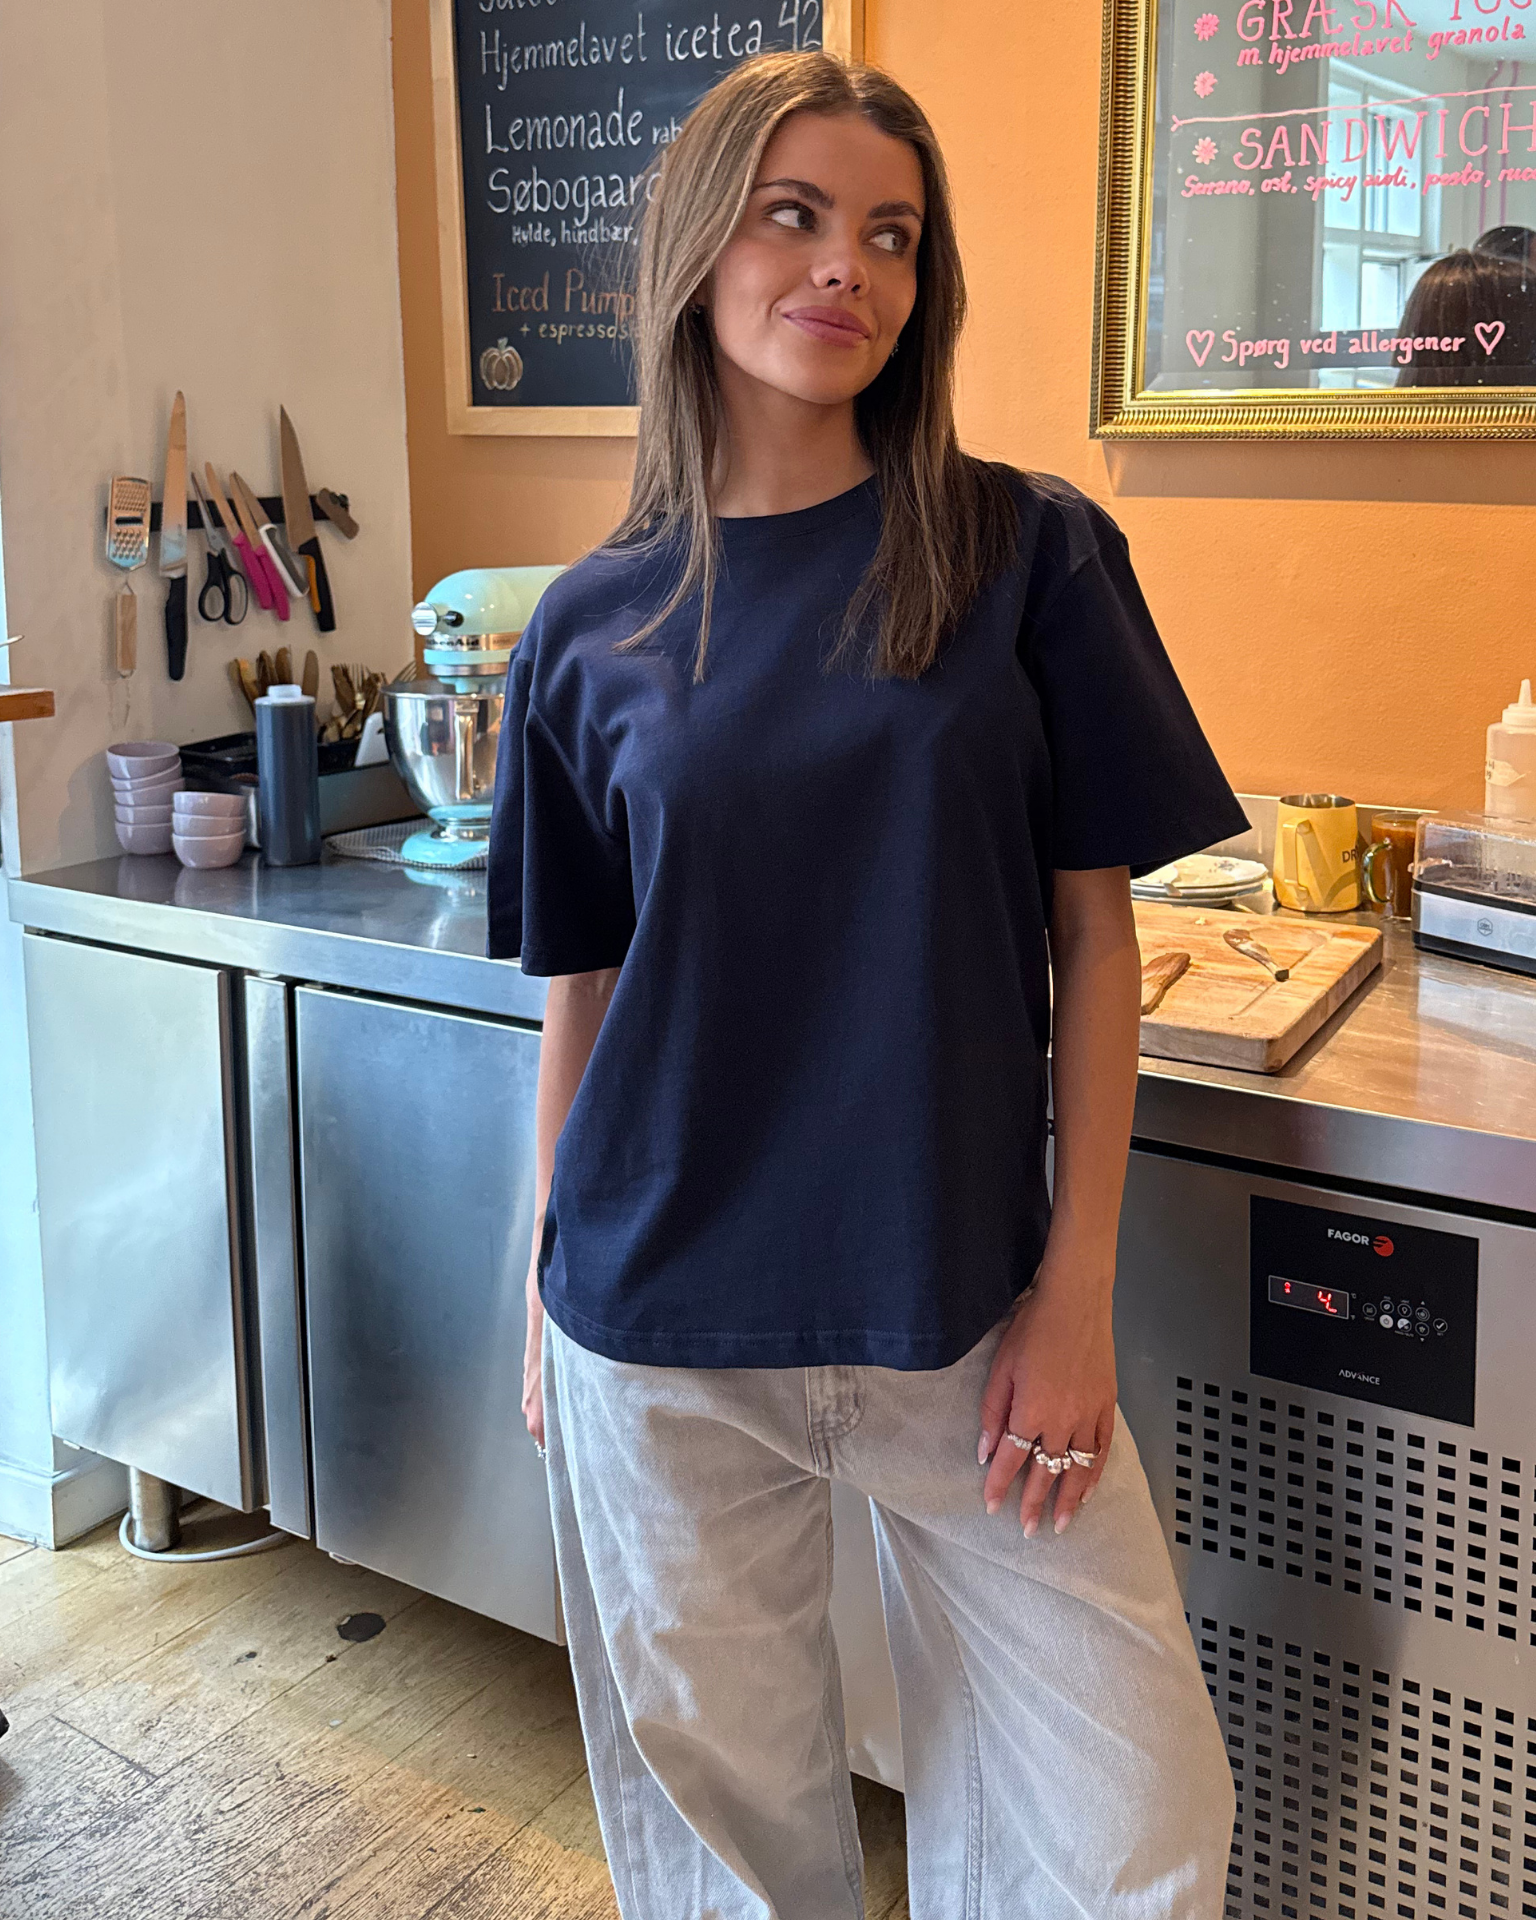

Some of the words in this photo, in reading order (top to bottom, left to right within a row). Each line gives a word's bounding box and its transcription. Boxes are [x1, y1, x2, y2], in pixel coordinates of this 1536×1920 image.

[480, 13, 647, 91] Hjemmelavet
[666, 13, 763, 60] icetea
[778, 0, 821, 52] 42
[1268, 29, 1414, 75] hjemmelavet
[1426, 15, 1526, 61] granola
[485, 87, 644, 154] Lemonade
[1233, 101, 1536, 171] SANDWICH
[1303, 172, 1358, 202] spicy
[1363, 165, 1417, 189] aioli,
[1422, 162, 1491, 196] pesto,
[511, 221, 557, 248] Hylde,
[492, 270, 549, 312] Iced
[1221, 330, 1290, 369] Spørg
[1300, 332, 1337, 354] ved
[1348, 331, 1466, 364] allergener
[1327, 1228, 1370, 1246] FAGOR
[1338, 1368, 1381, 1385] ADVANCE
